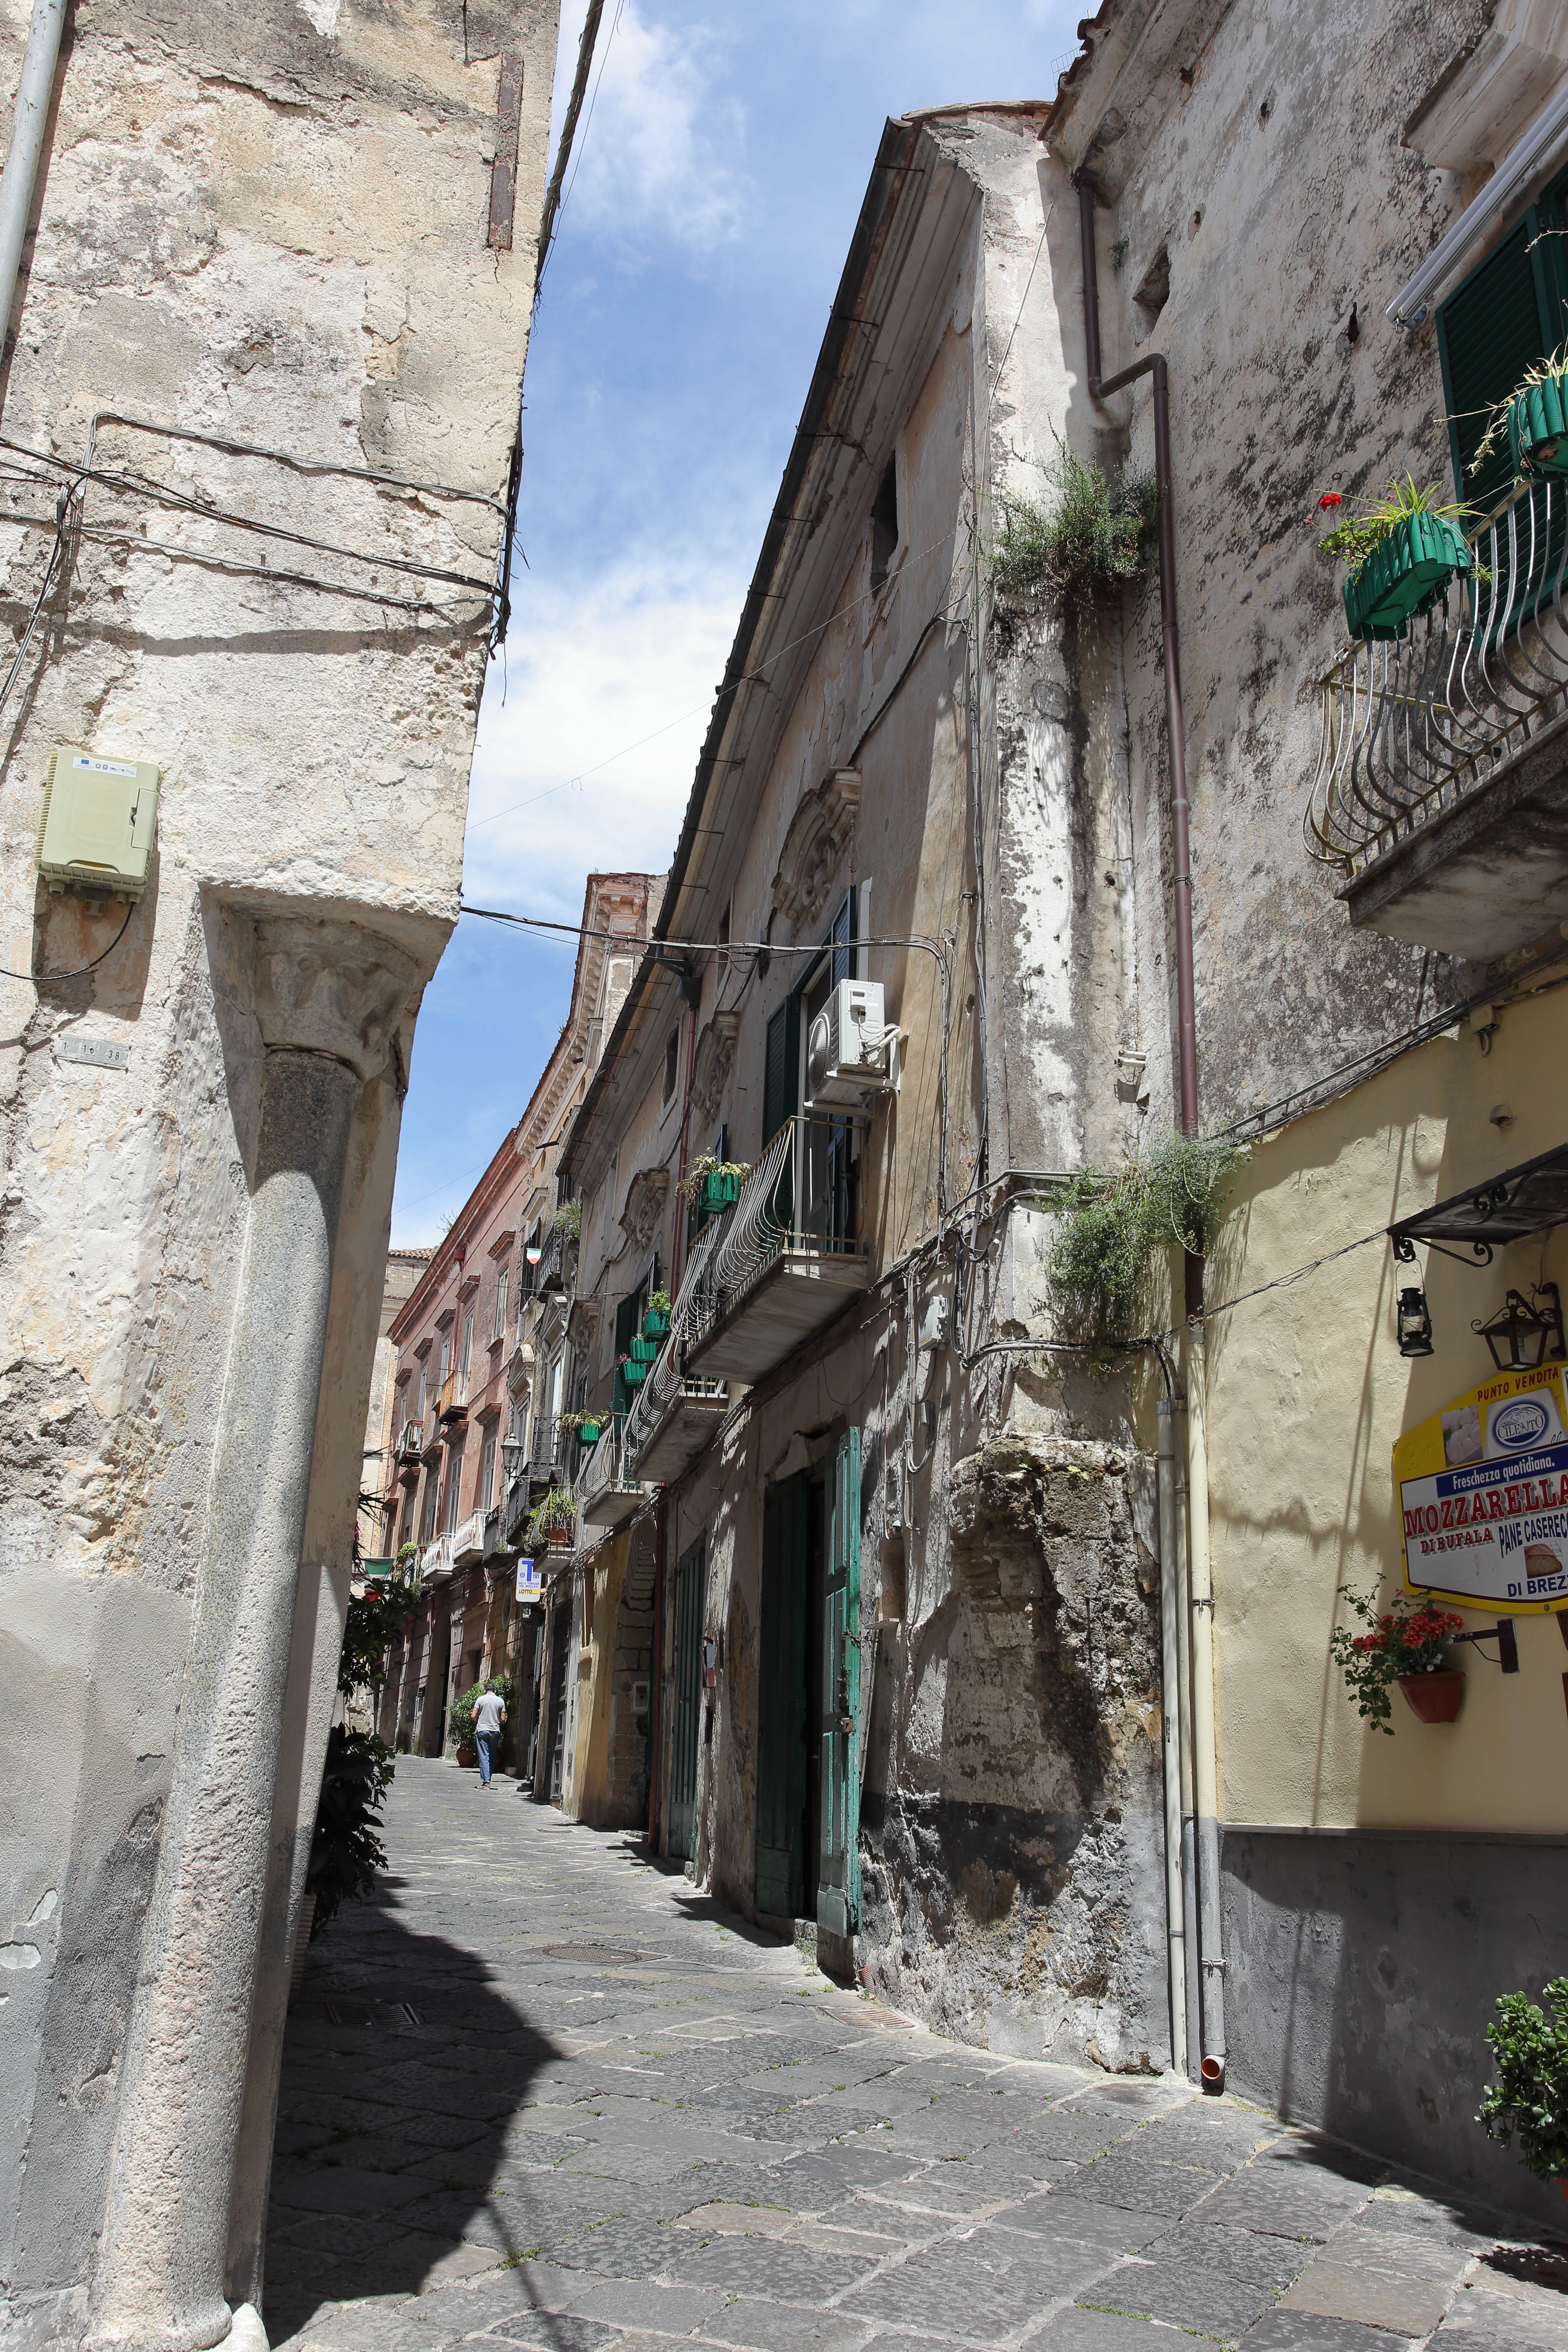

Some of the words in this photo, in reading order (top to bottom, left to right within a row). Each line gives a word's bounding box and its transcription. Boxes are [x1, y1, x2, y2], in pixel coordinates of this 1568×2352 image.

[108, 1050, 120, 1060] 38
[1477, 1382, 1509, 1402] PUNTO
[1515, 1366, 1559, 1390] VENDITA
[1498, 1415, 1544, 1439] CILENTO
[1453, 1469, 1501, 1490] Freschezza
[1503, 1456, 1555, 1482] quotidiana.
[1420, 1538, 1435, 1554] DI
[1436, 1527, 1493, 1551] BUFALA
[1498, 1522, 1523, 1559] PANE
[1524, 1512, 1568, 1542] CASEREC
[522, 1560, 534, 1581] T
[1507, 1582, 1522, 1598] DI
[1527, 1575, 1568, 1595] BREZ
